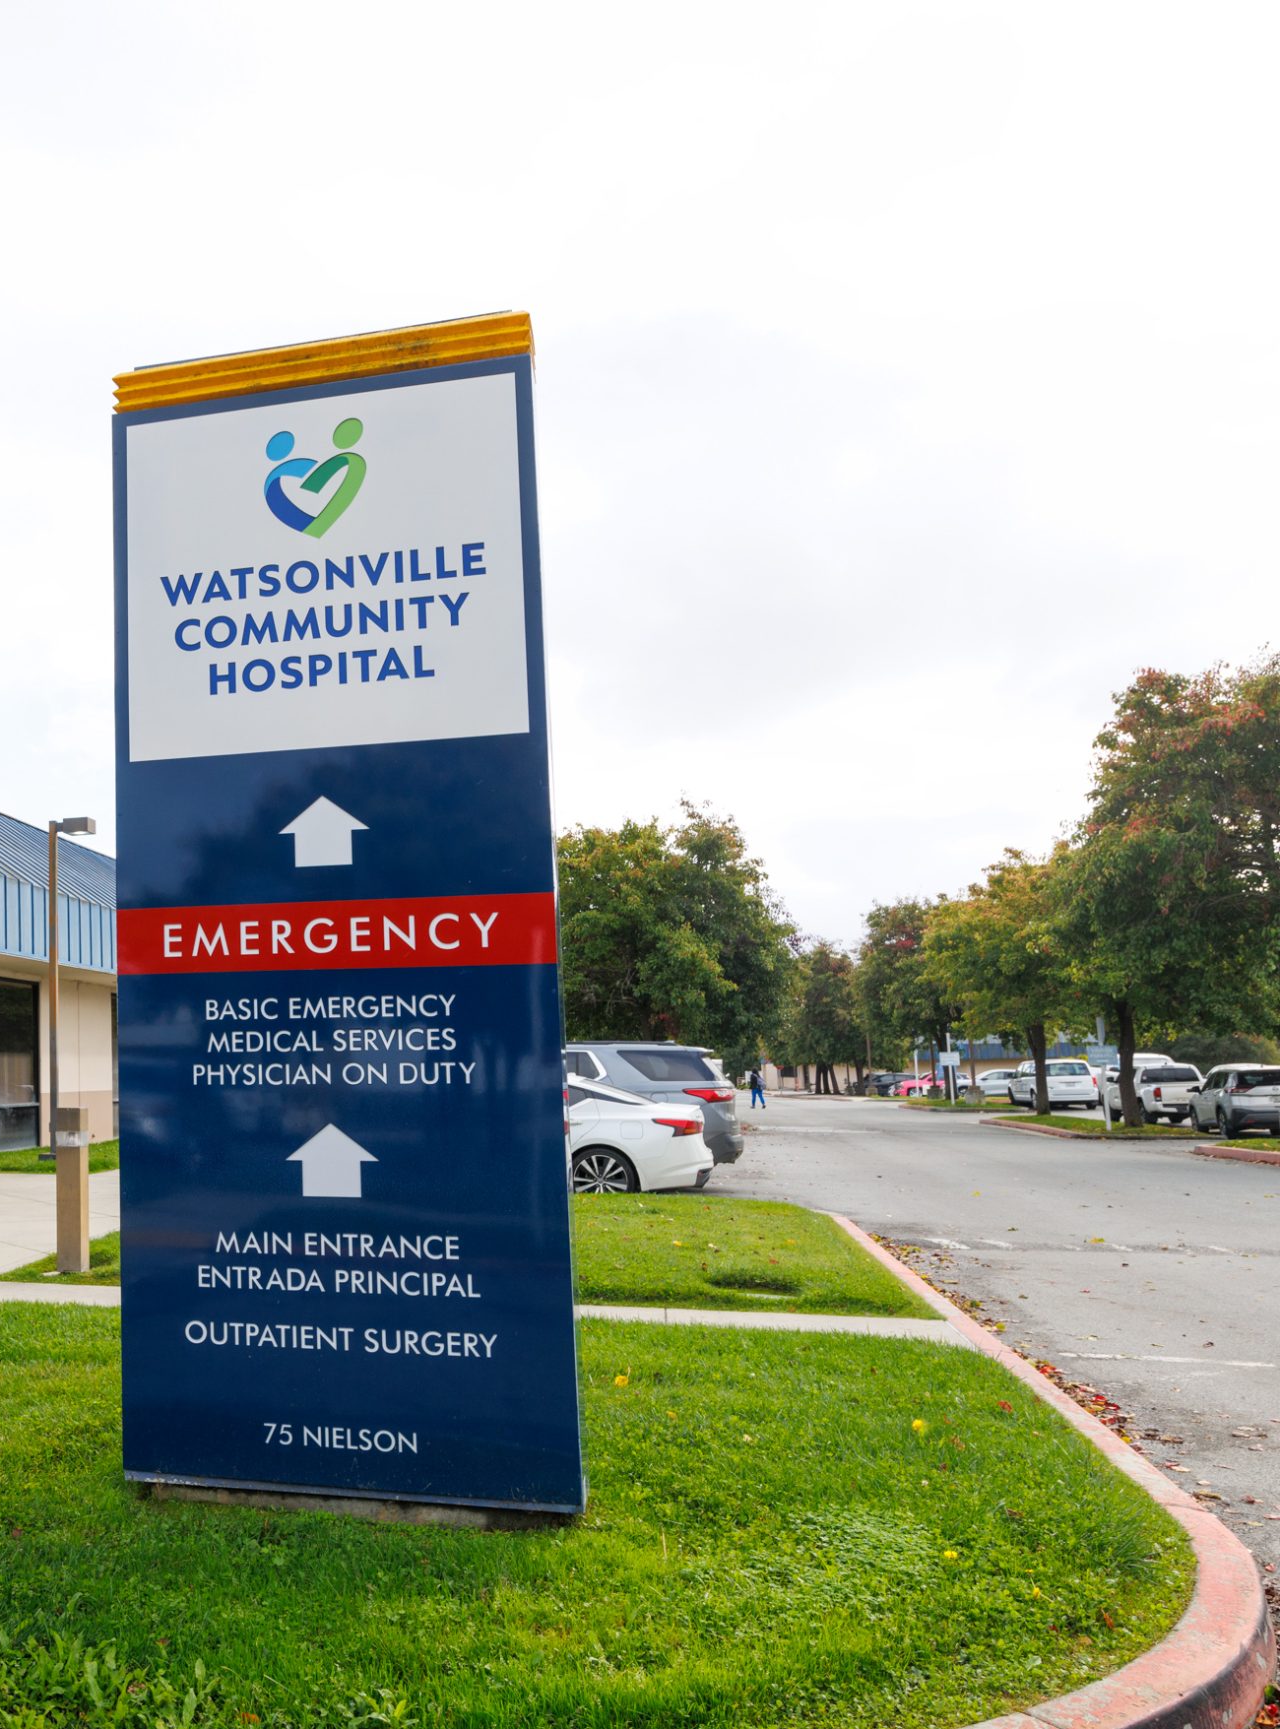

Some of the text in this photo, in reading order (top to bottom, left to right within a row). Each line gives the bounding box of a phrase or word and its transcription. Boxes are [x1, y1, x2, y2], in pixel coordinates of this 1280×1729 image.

[161, 542, 486, 606] WATSONVILLE
[175, 592, 469, 652] COMMUNITY
[209, 645, 435, 695] HOSPITAL
[162, 912, 499, 959] EMERGENCY
[205, 993, 456, 1021] BASIC EMERGENCY
[207, 1027, 457, 1053] MEDICAL SERVICES
[192, 1061, 477, 1086] PHYSICIAN ON DUTY
[215, 1231, 460, 1261] MAIN ENTRANCE
[197, 1264, 482, 1299] ENTRADA PRINCIPAL
[184, 1319, 498, 1359] OUTPATIENT SURGERY
[263, 1422, 418, 1454] 75 NIELSON
